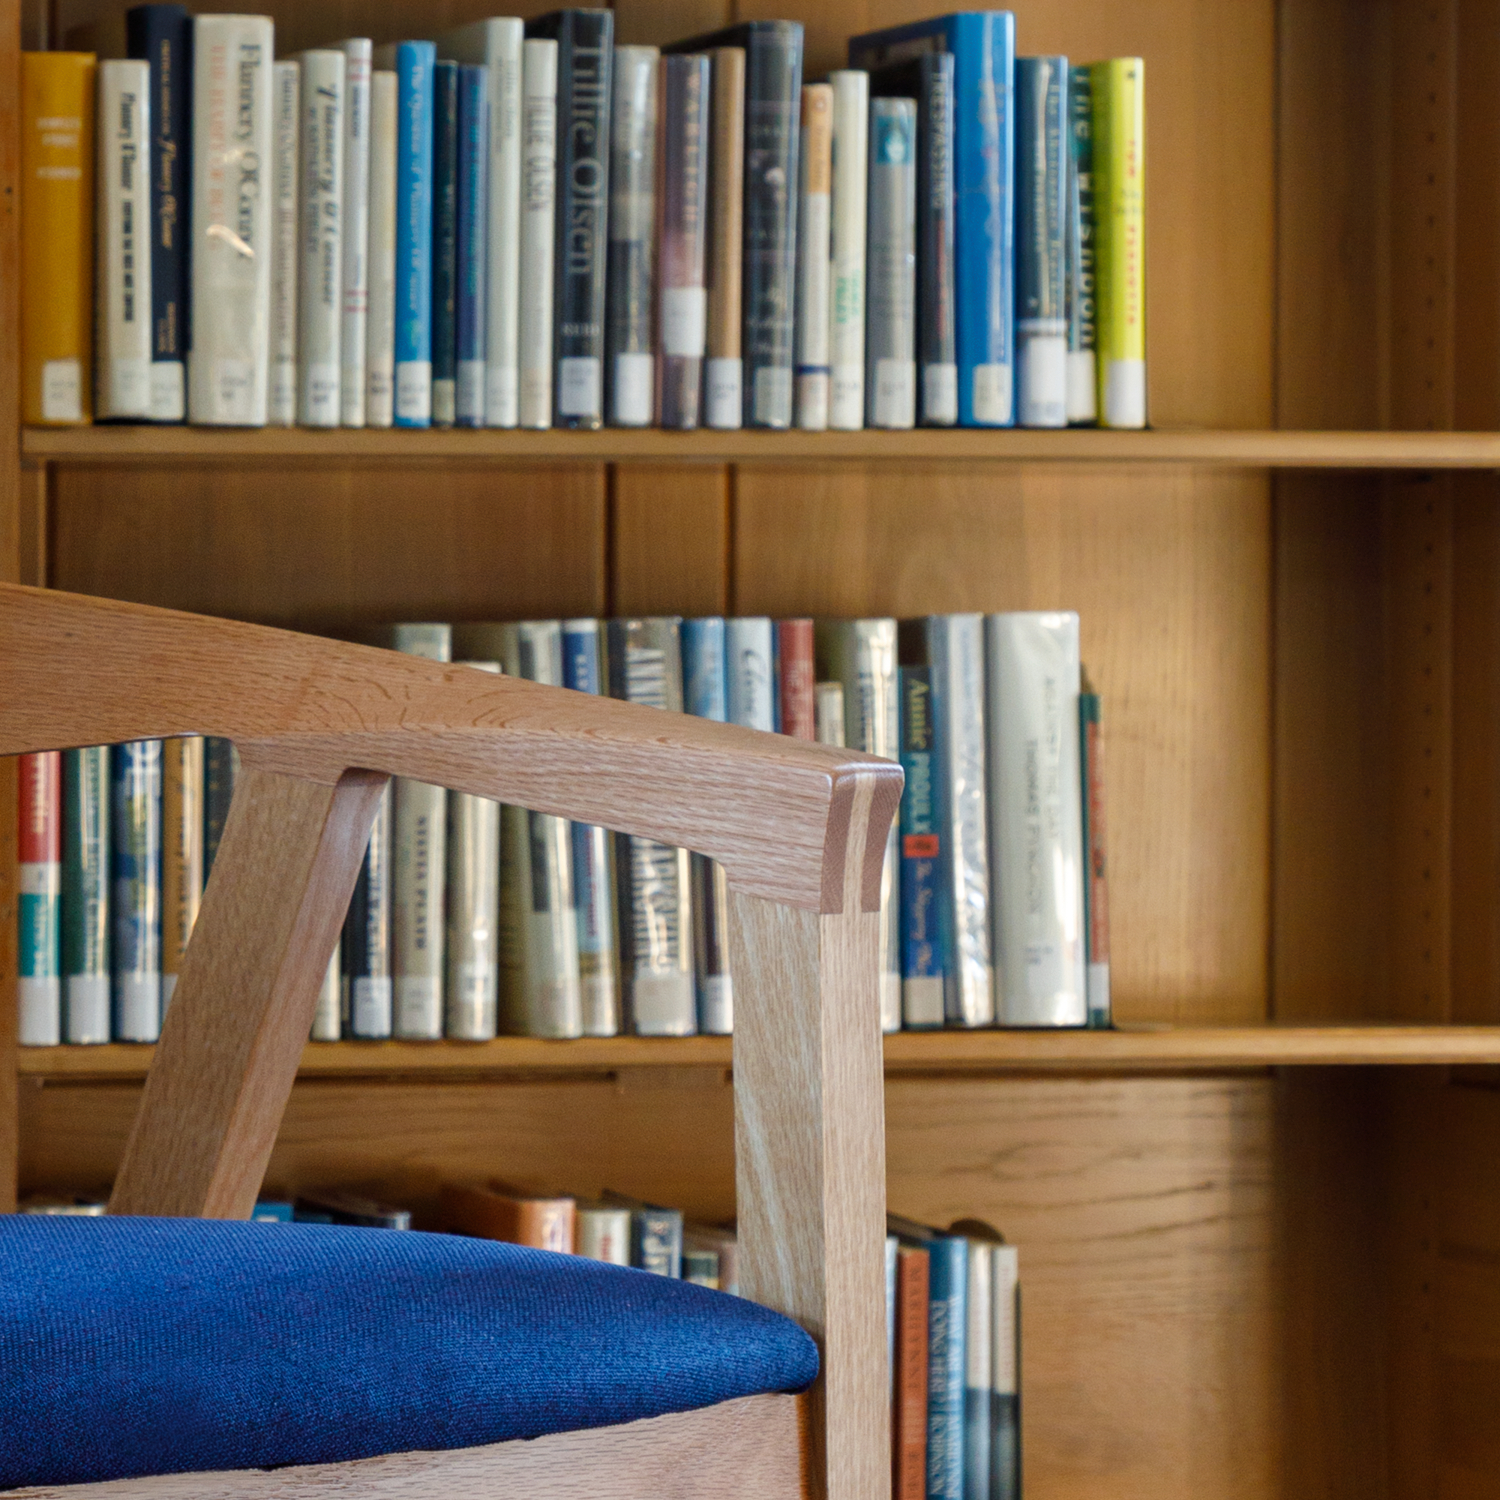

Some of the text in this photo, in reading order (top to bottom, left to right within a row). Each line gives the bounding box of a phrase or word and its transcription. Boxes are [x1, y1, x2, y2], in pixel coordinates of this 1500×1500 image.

[236, 43, 262, 141] Flannery
[566, 33, 606, 275] Tillie Olsen
[684, 72, 700, 239] WARLIGHT
[903, 677, 931, 836] Annie PROULX
[1024, 738, 1040, 818] THOMAS
[930, 1300, 946, 1353] DOING
[930, 1415, 947, 1496] ROBINSON
